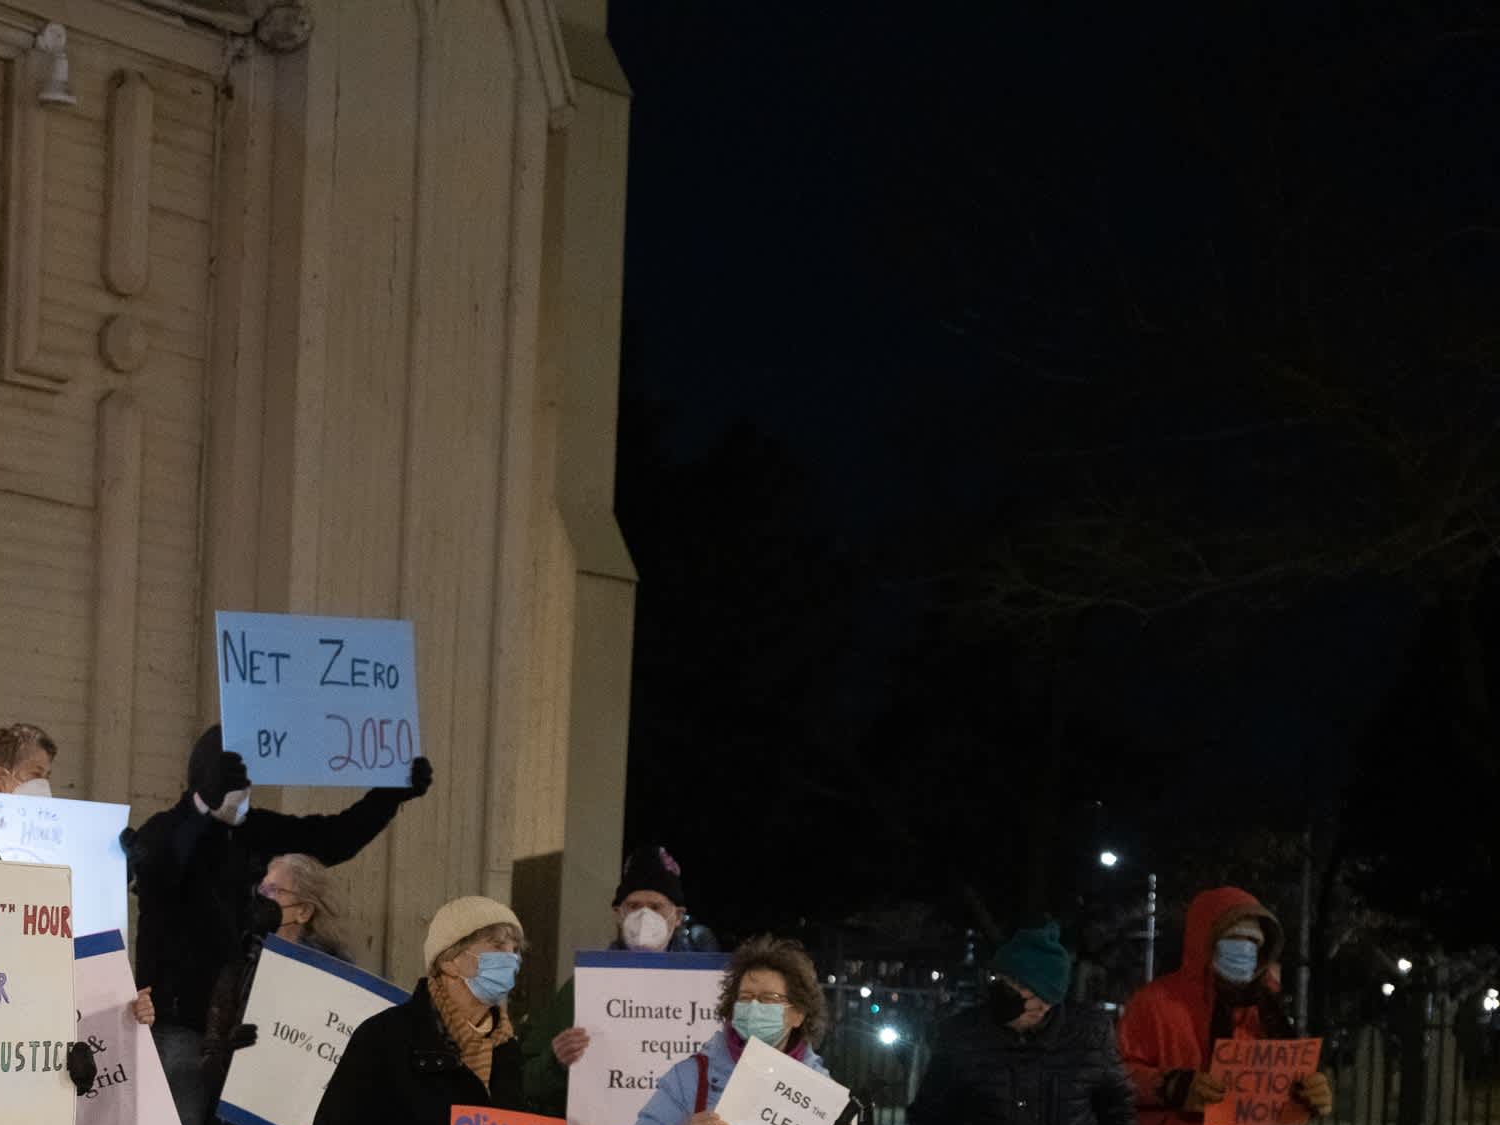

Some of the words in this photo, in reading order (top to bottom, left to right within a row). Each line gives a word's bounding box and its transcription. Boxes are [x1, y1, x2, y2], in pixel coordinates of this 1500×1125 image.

[258, 729, 288, 758] BY
[326, 714, 413, 771] 2050
[23, 904, 72, 938] HOUR
[606, 999, 682, 1019] Climate
[87, 1035, 107, 1053] &
[272, 1021, 313, 1053] 100%
[1216, 1042, 1317, 1067] CLIMATE
[774, 1081, 812, 1109] PASS
[812, 1105, 827, 1120] THE
